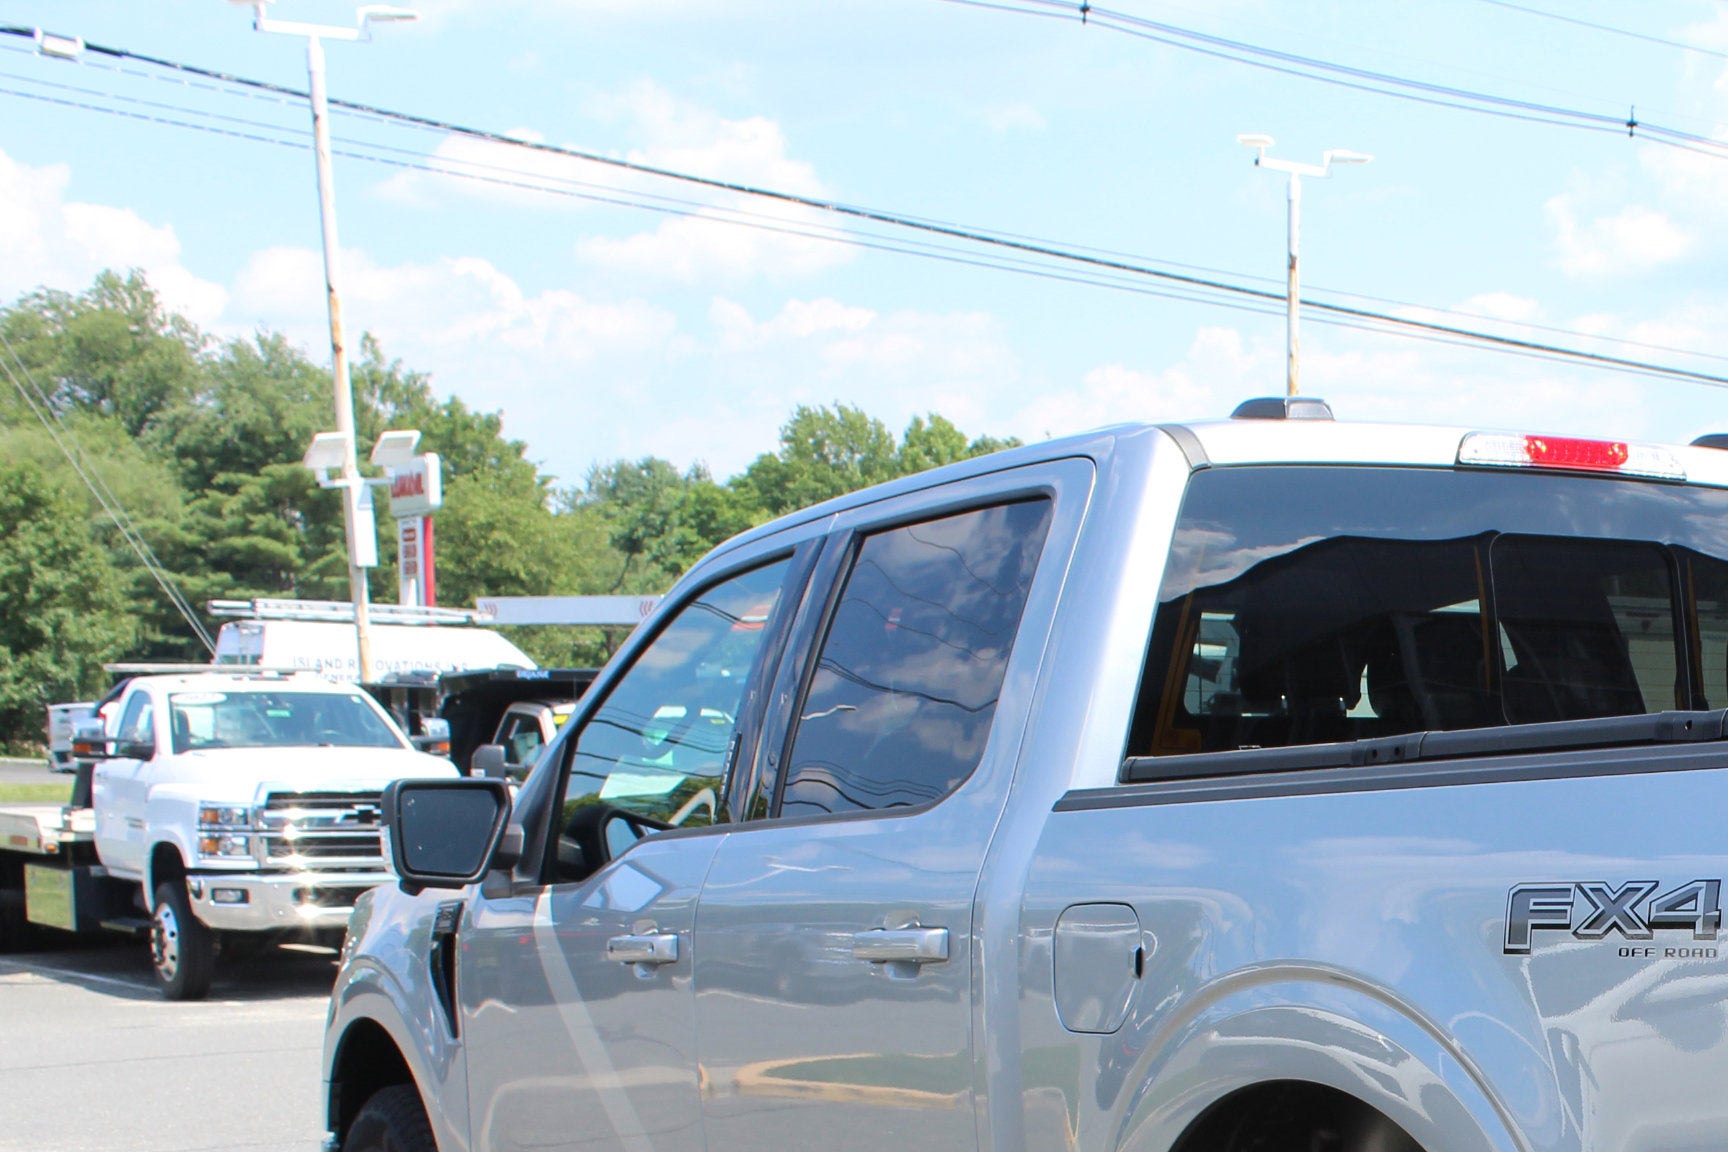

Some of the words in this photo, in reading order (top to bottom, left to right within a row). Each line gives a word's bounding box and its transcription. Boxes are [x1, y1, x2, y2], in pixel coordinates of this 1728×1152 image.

[1503, 879, 1721, 954] FX4
[1618, 947, 1657, 958] OFF
[1664, 947, 1718, 958] ROAD
